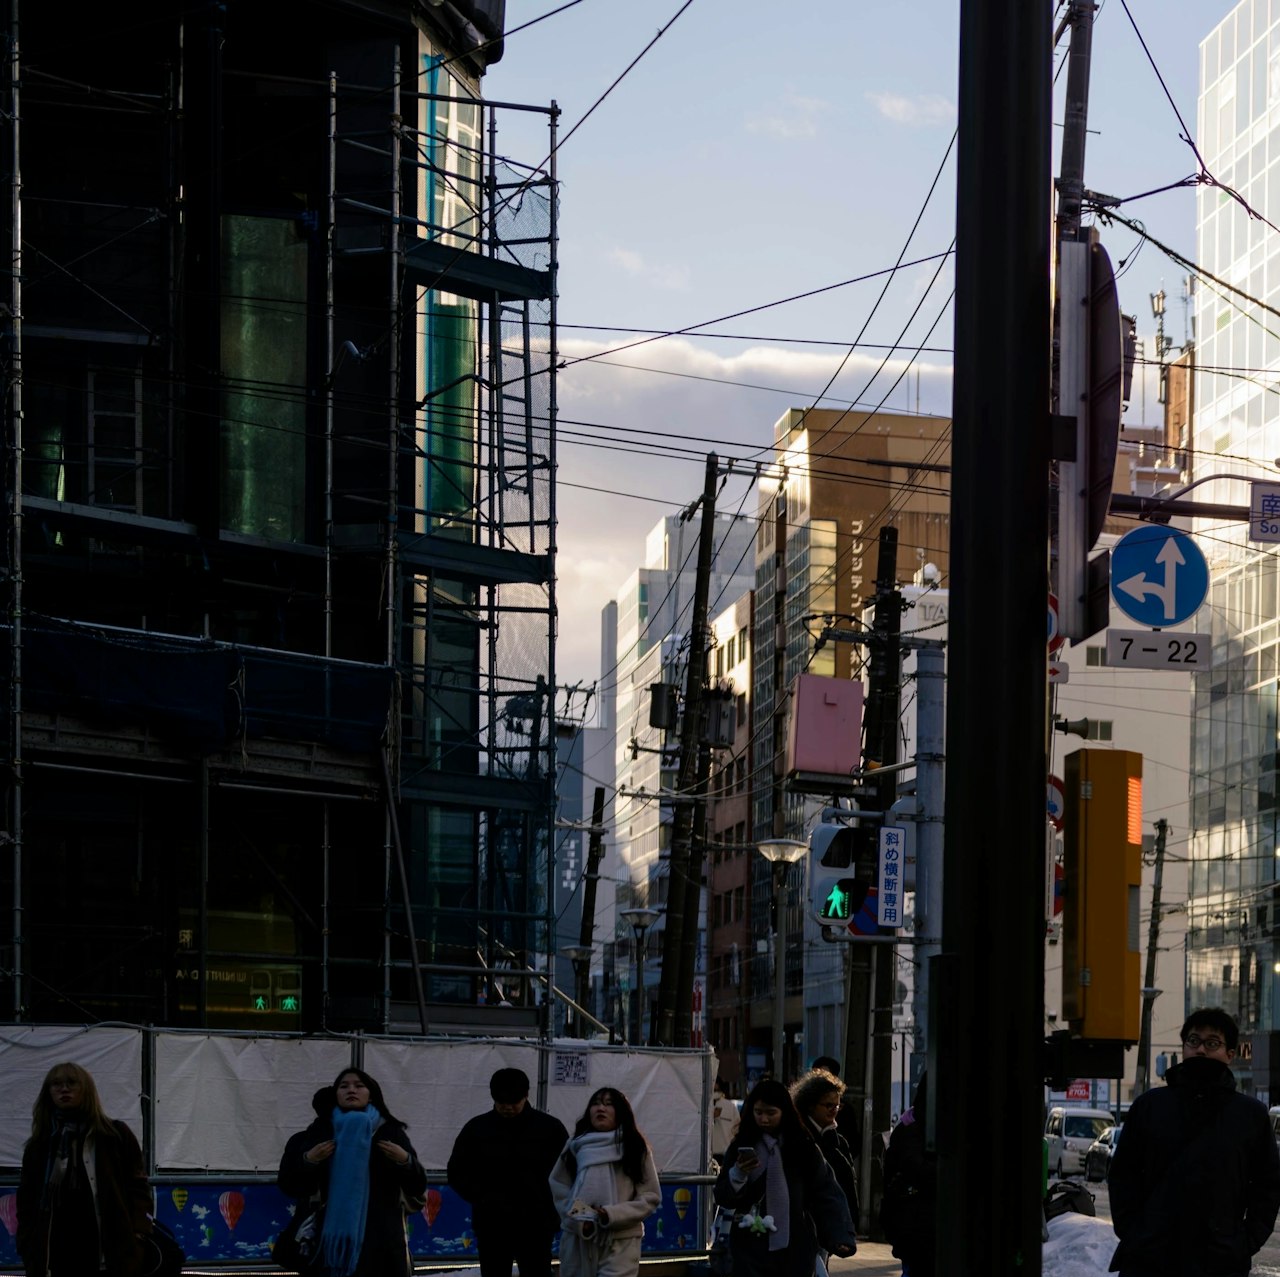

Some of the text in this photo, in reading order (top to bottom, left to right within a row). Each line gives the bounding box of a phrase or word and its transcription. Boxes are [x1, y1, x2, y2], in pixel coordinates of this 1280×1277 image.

[883, 831, 901, 924] 斜め横断専用
